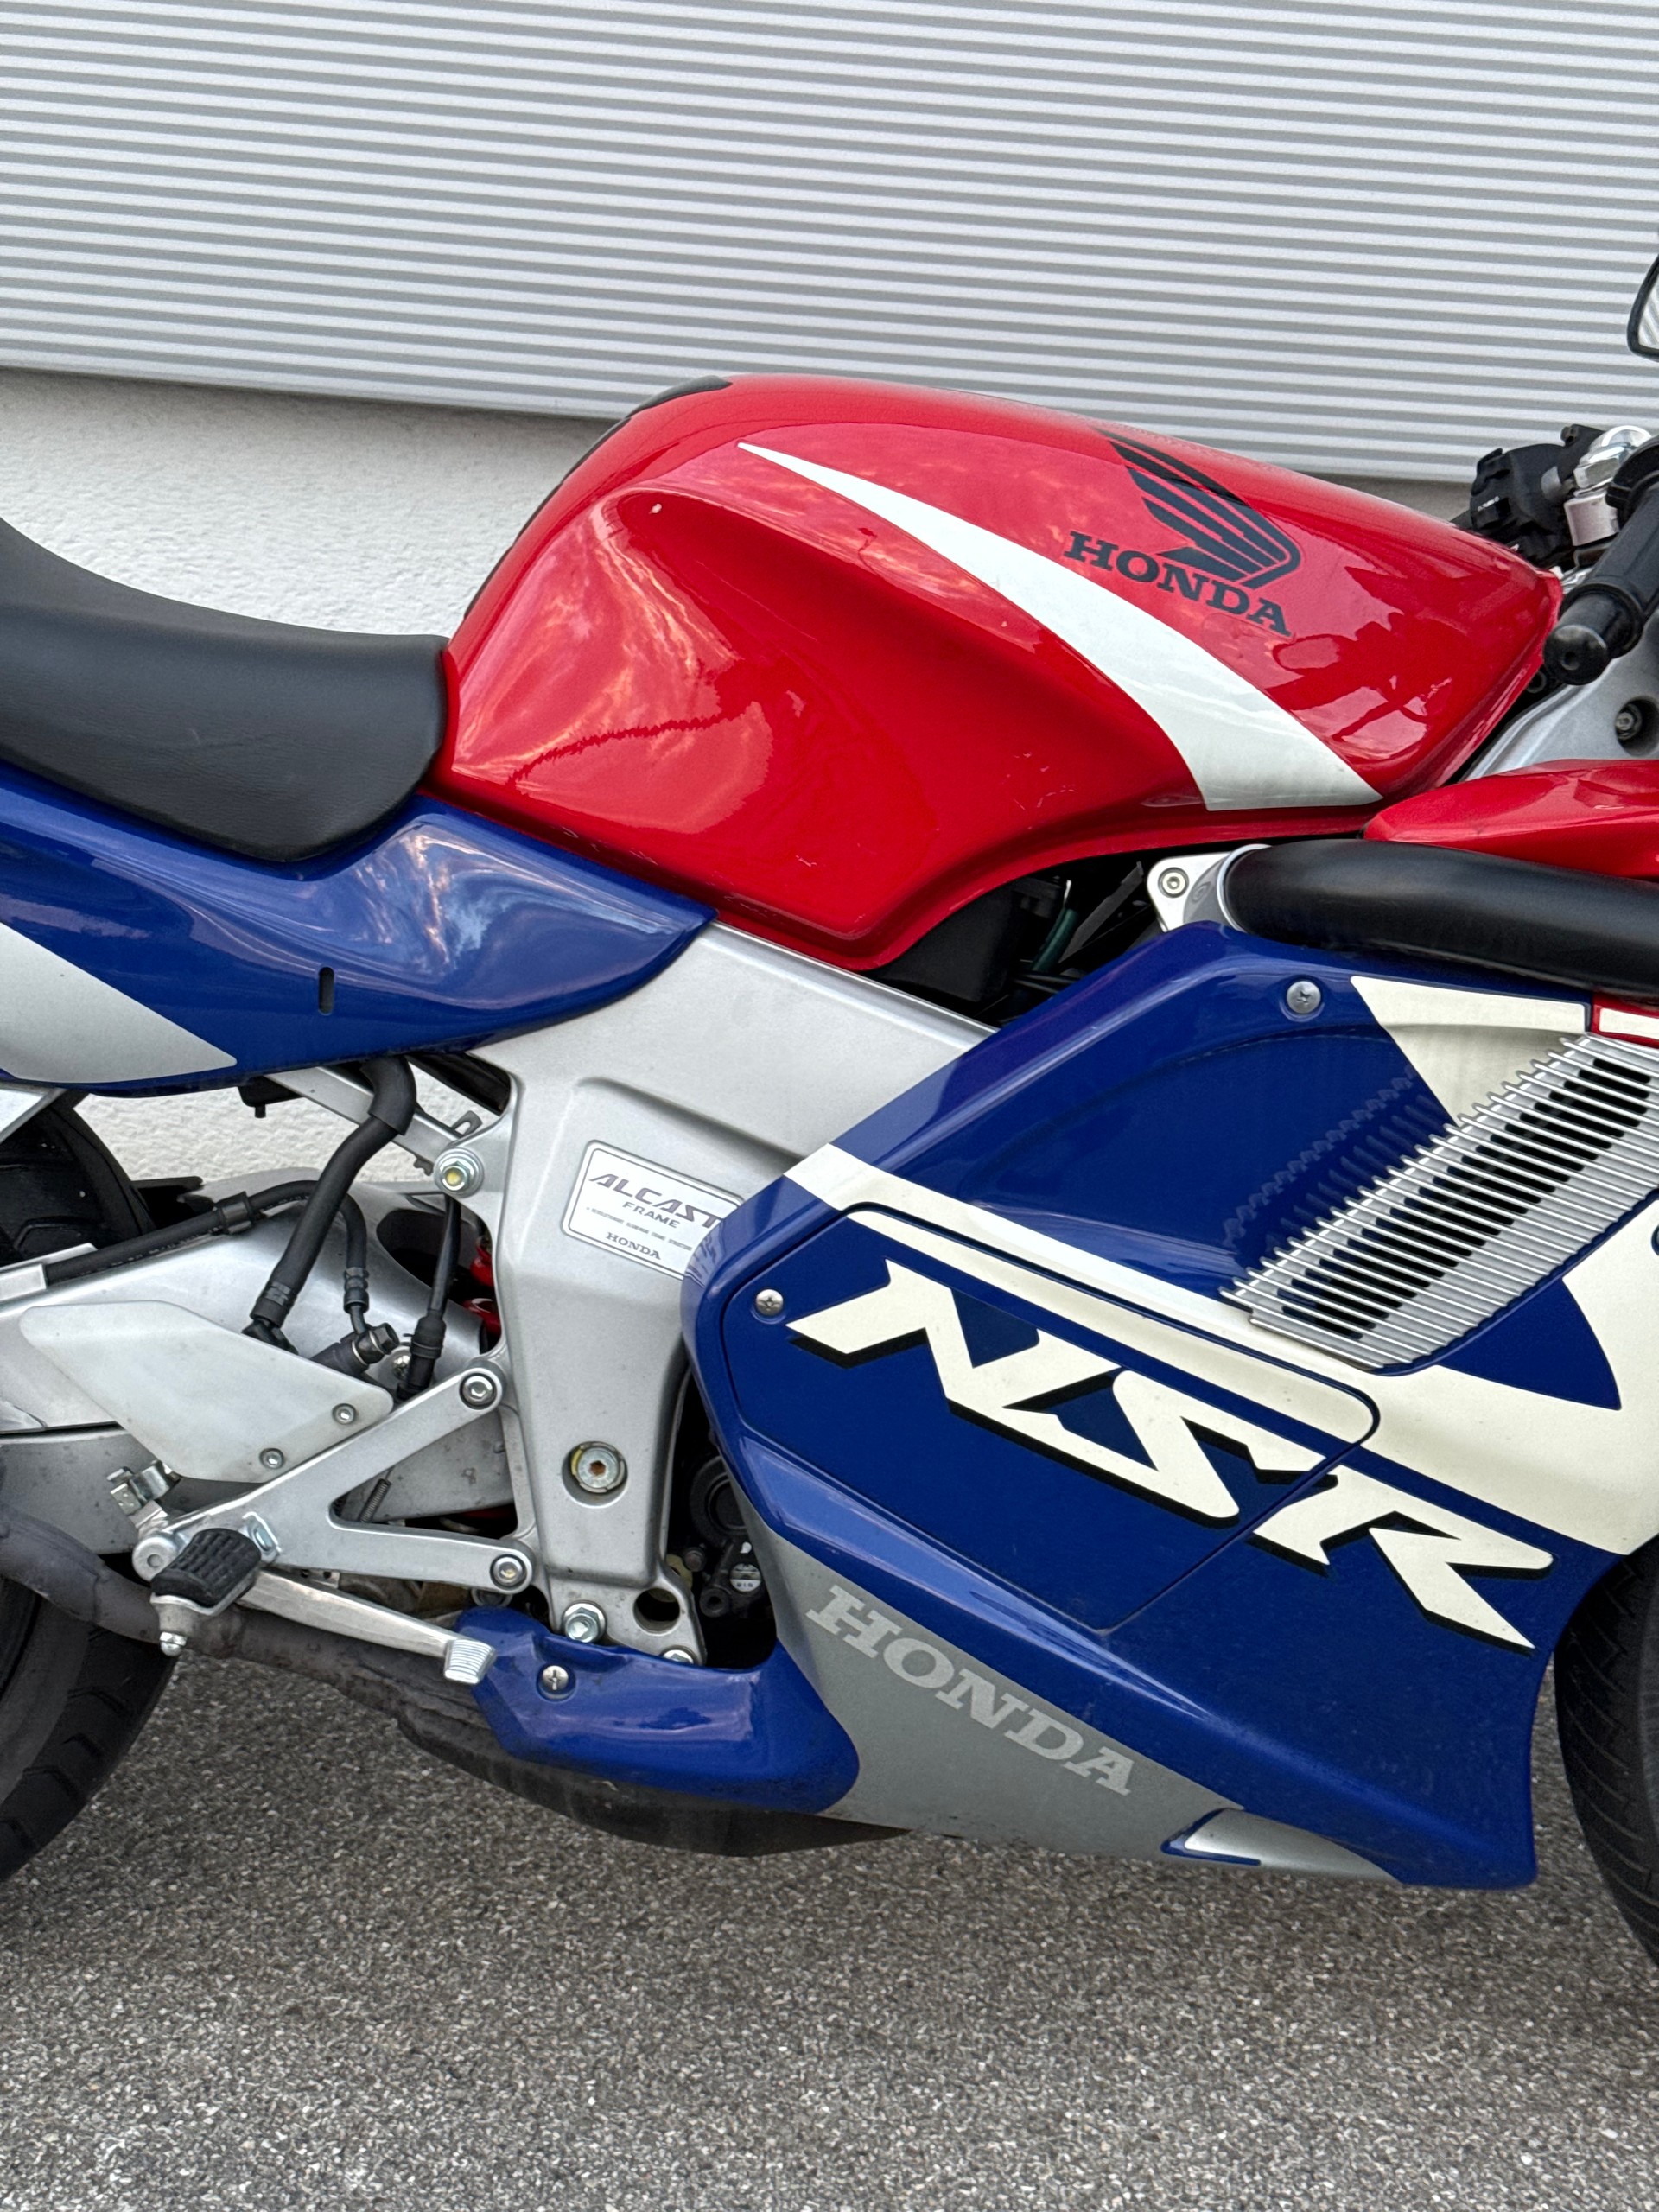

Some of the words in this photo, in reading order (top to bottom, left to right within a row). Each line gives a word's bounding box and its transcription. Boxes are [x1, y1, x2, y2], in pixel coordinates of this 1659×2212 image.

[1064, 531, 1291, 637] HONDA
[588, 1173, 722, 1229] ALCAST
[622, 1201, 680, 1228] FRAME
[606, 1232, 661, 1260] HONDA
[786, 1260, 1554, 1649] NSR
[806, 1585, 1133, 1795] HONDA
